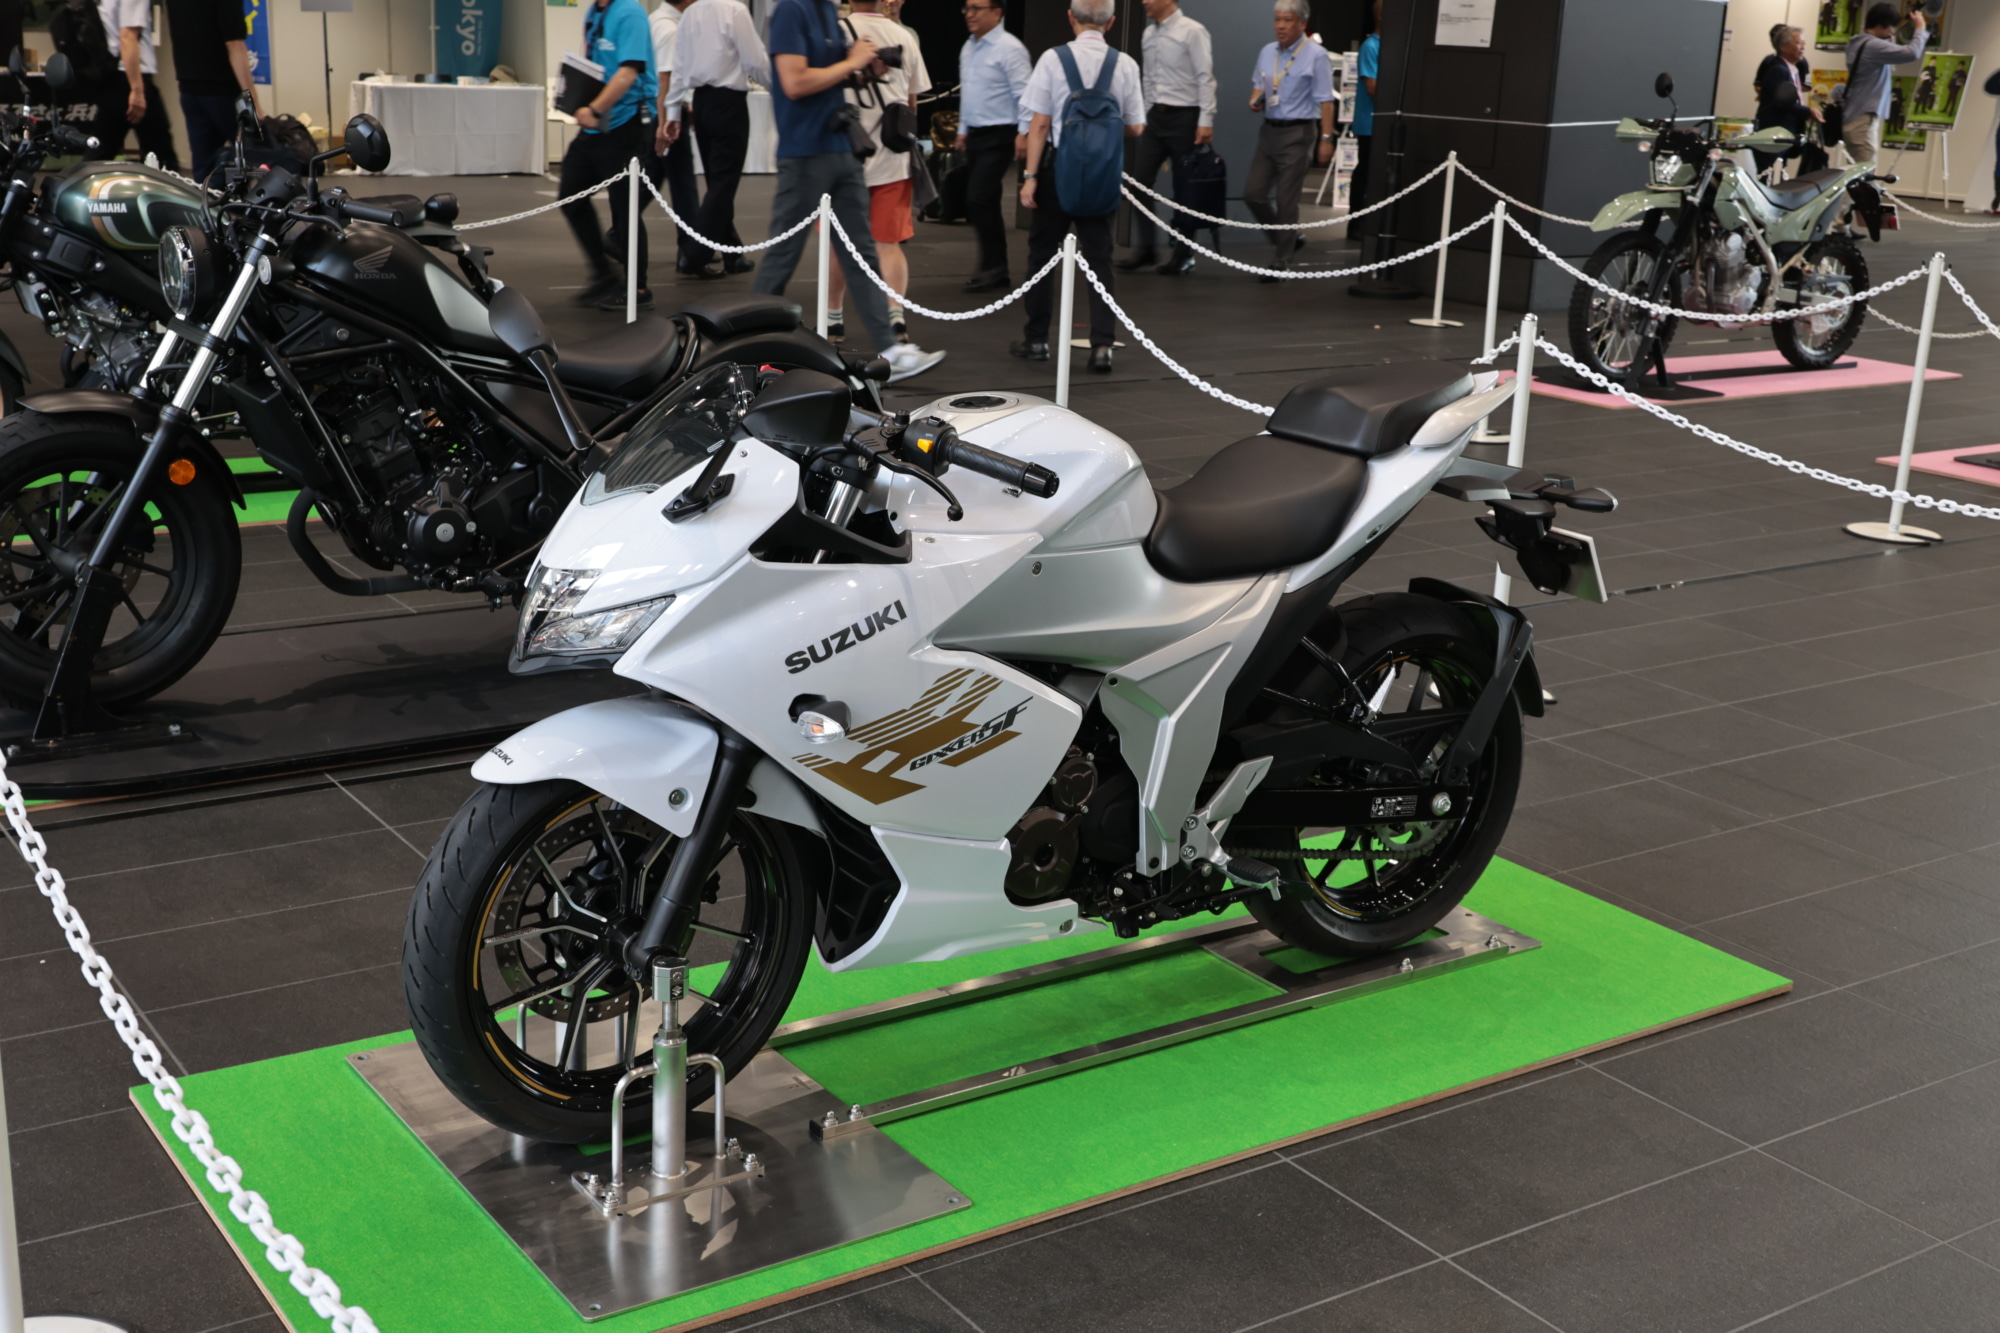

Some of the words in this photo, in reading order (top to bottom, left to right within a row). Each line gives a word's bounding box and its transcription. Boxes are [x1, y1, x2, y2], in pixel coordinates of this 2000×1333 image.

[87, 202, 128, 214] YAMAHA
[354, 272, 398, 280] HONDA
[784, 599, 907, 675] SUZUKI
[909, 726, 986, 772] GIXXER
[974, 695, 1034, 745] SF
